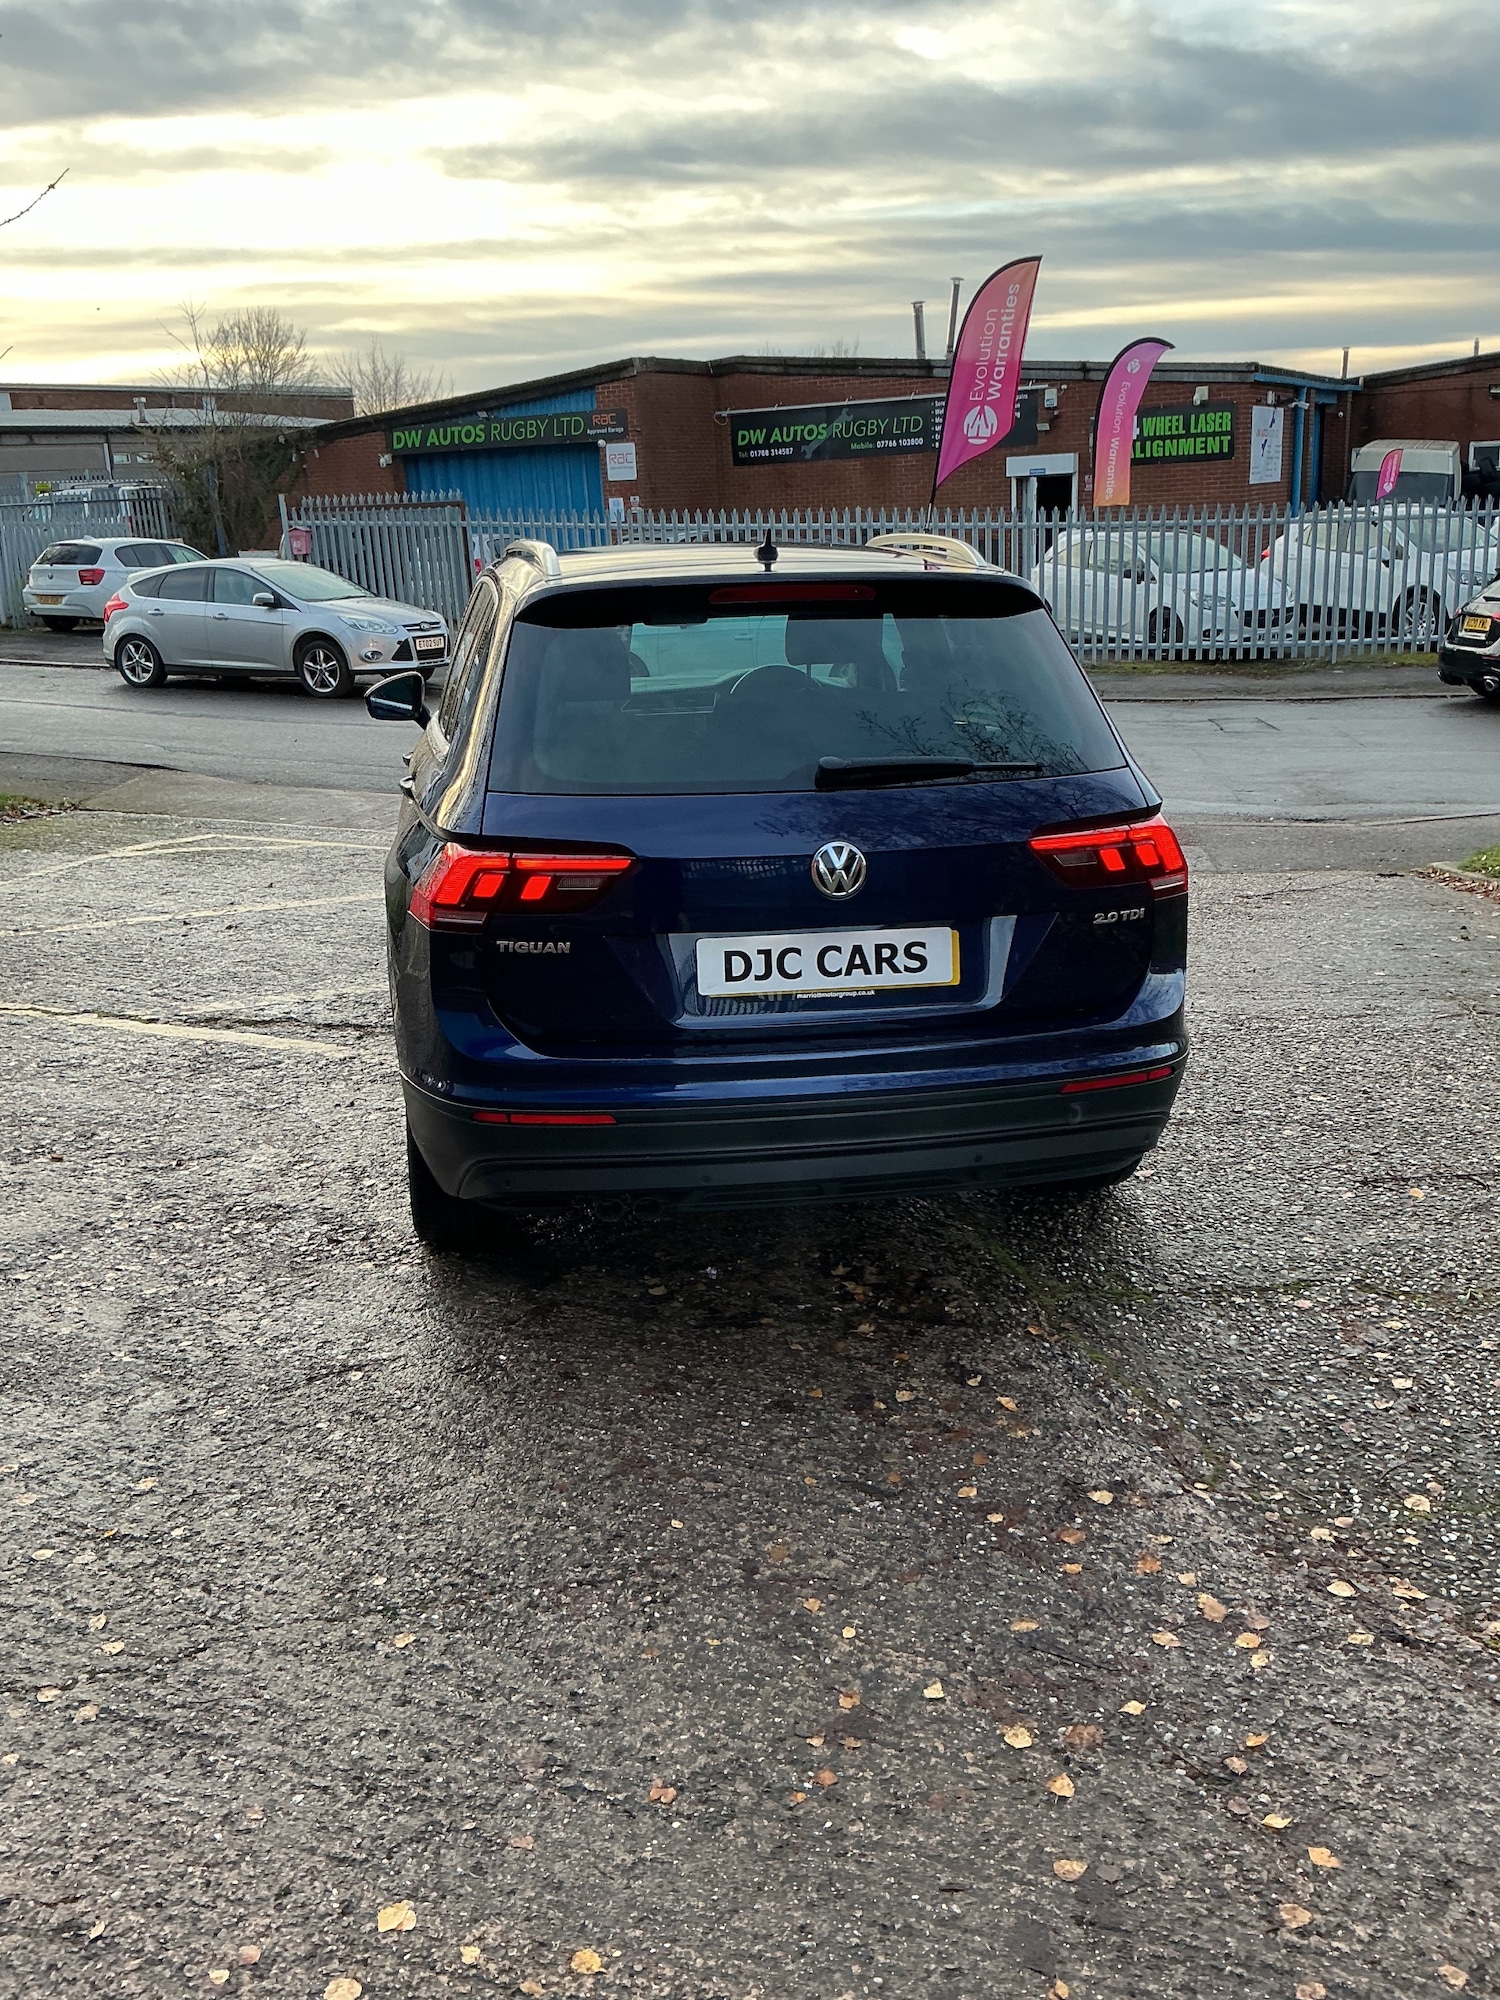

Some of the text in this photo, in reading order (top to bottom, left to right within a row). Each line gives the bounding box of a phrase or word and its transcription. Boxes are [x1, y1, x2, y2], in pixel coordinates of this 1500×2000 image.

[969, 309, 998, 401] Evolution
[986, 283, 1020, 401] Warranties
[393, 416, 584, 449] DW AUTOS RUGBY LTD
[737, 415, 923, 446] DW AUTOS RUGBY LTD
[1142, 415, 1185, 437] WHEEL
[1190, 411, 1232, 434] LASER
[850, 442, 875, 450] Mobile:
[876, 440, 897, 448] 07766
[1105, 381, 1131, 501] Evolution Warranties
[1120, 908, 1145, 921] TDI
[496, 940, 571, 953] TIGUAN
[723, 941, 928, 982] DJC CARS
